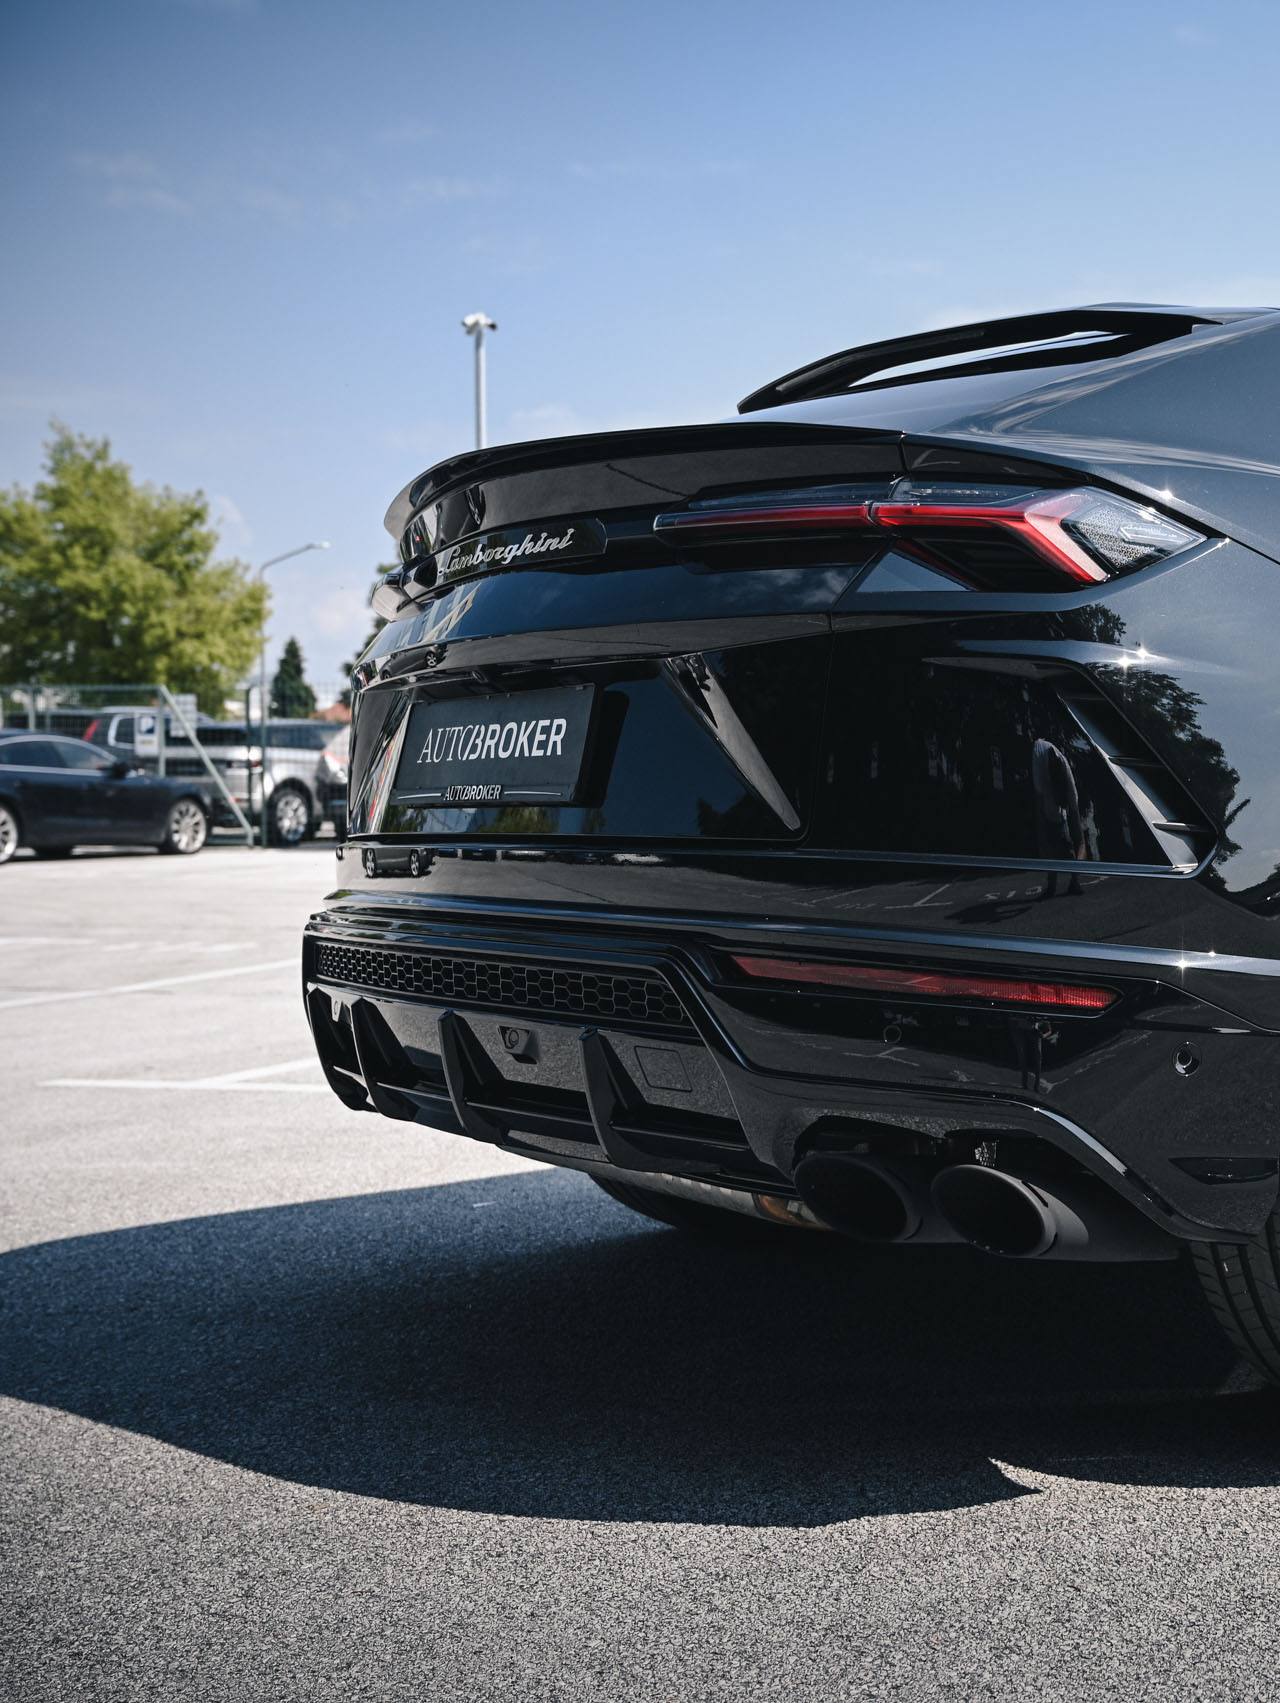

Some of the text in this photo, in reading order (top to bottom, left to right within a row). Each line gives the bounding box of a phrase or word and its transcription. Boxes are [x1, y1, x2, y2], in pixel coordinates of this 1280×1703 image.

[438, 528, 575, 575] Lamborghini
[417, 718, 567, 764] AUTOBROKER
[444, 785, 502, 801] AUTOBROKER
